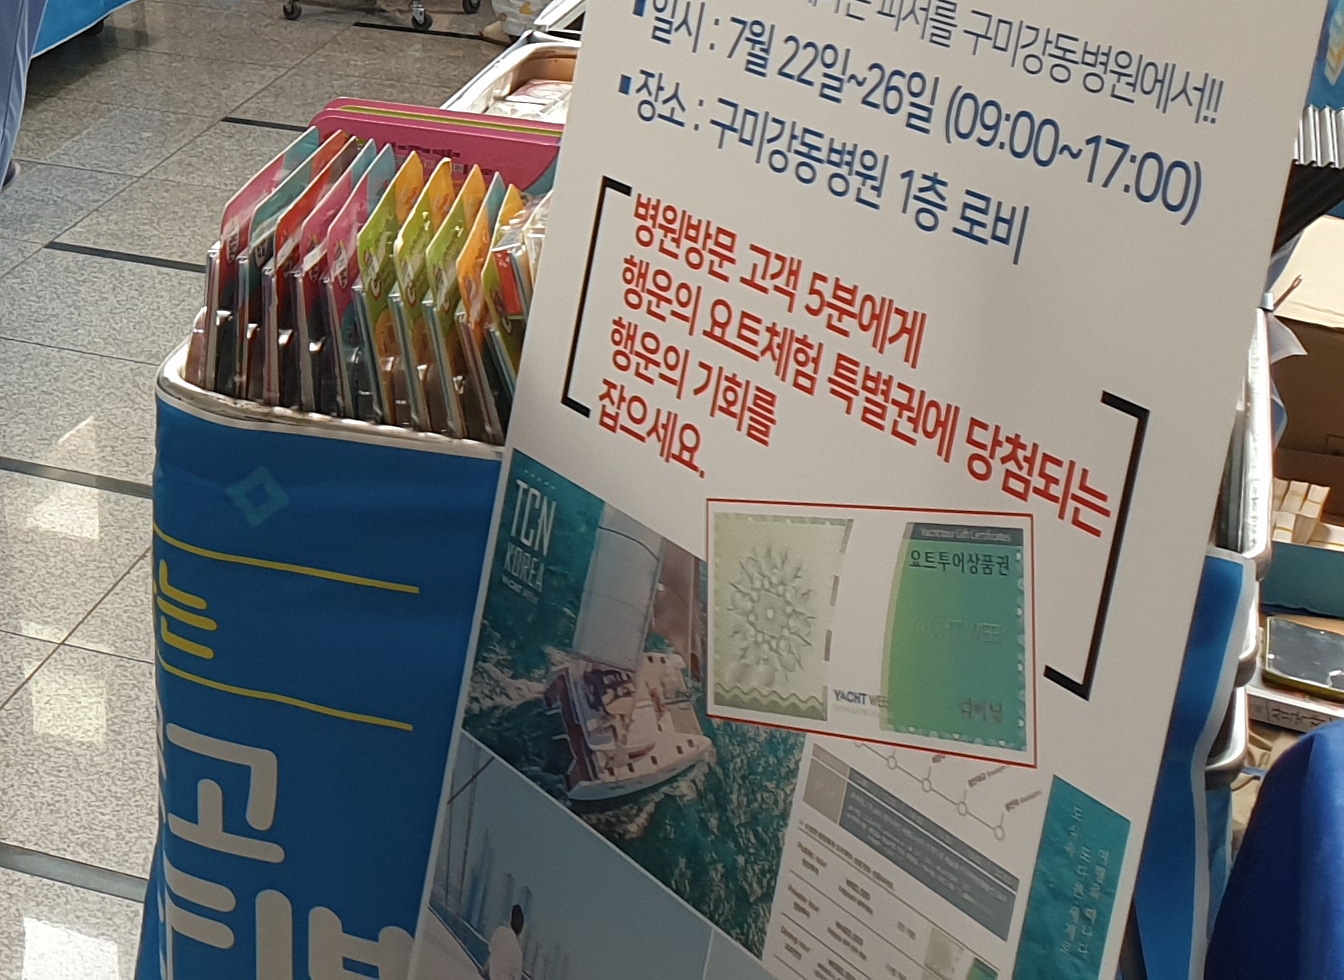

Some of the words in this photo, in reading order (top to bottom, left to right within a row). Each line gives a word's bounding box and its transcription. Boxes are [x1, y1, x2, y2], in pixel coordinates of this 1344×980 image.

[726, 16, 776, 78] 7월
[777, 35, 940, 135] 22일~26일
[944, 85, 1203, 226] (09:00~17:00)
[963, 9, 1224, 124] 구미강동병원에서!!
[635, 68, 687, 128] 장소
[709, 97, 890, 211] 구미강동병원
[899, 169, 949, 232] 1층
[952, 189, 1030, 266] 로비
[633, 193, 738, 283] 병원방문
[740, 242, 803, 314] 고객
[804, 271, 927, 369] 5분에게
[597, 378, 706, 480] 잡으세요.
[610, 316, 690, 400] 행운의
[693, 359, 778, 448] 기회를
[621, 255, 703, 337] 행운의
[702, 298, 825, 397] 요트체험
[827, 353, 961, 464] 특별권에
[964, 416, 1112, 538] 당첨되는
[503, 542, 547, 593] KOREA
[510, 479, 558, 557] TCN
[909, 549, 1010, 577] 요트투어상품권
[833, 689, 868, 707] YACHT
